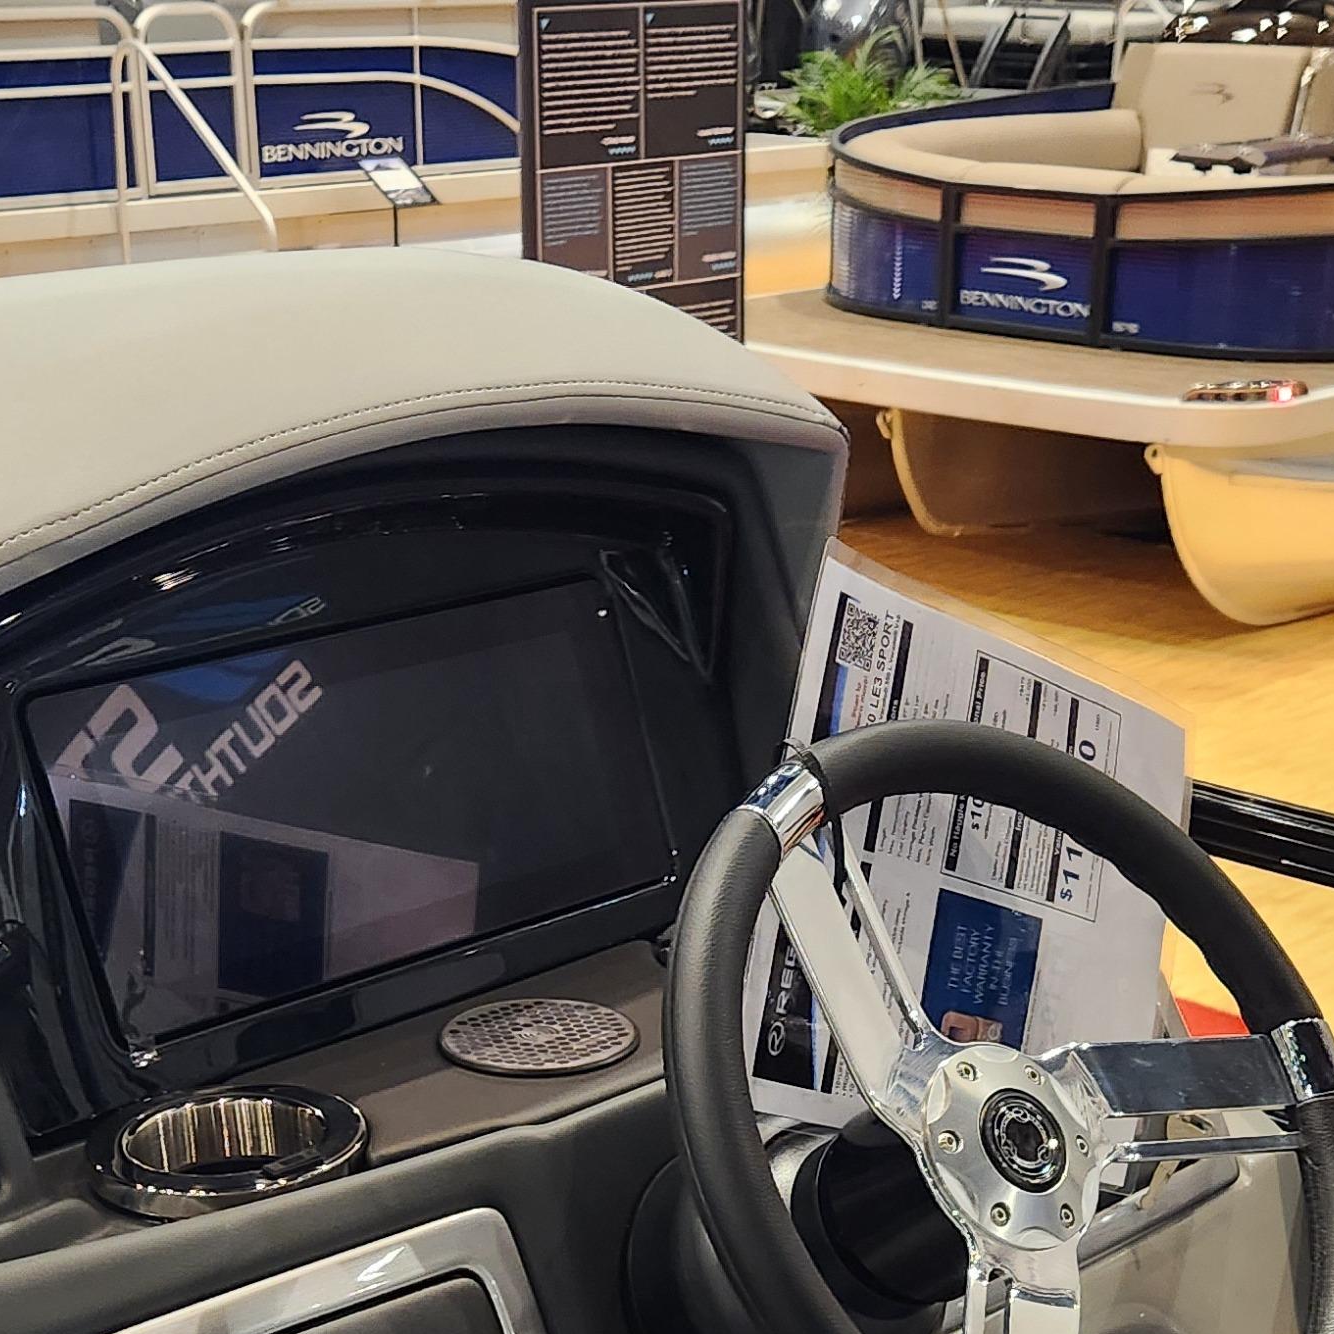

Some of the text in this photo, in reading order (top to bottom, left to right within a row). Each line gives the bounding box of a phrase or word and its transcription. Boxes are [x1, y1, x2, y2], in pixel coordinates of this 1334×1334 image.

[261, 136, 404, 163] BENNINGTON
[959, 289, 1091, 319] BENNINGTON
[875, 609, 894, 672] SPORT
[869, 675, 883, 709] LE3
[976, 670, 986, 699] Price
[952, 802, 966, 840] Haggle
[949, 840, 959, 857] No
[951, 923, 967, 959] BEST
[960, 927, 980, 994] FACTORY
[973, 922, 995, 1005] WARRANTY
